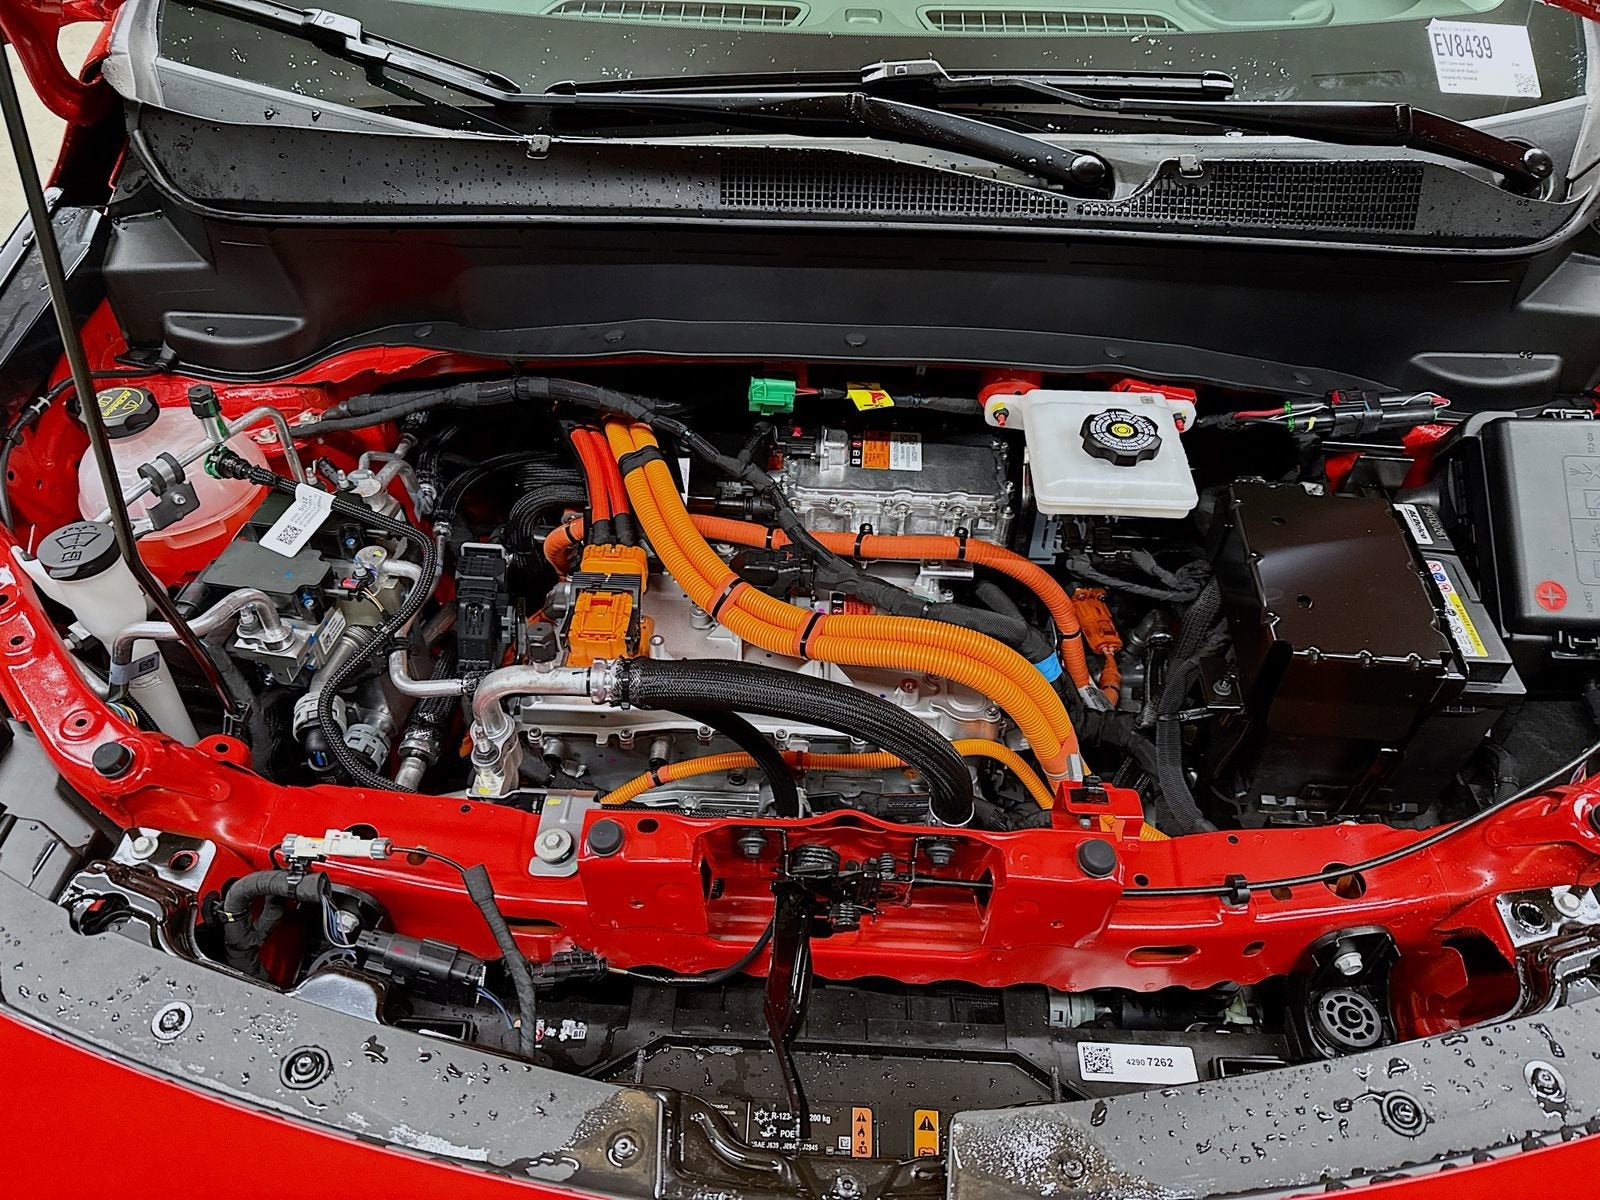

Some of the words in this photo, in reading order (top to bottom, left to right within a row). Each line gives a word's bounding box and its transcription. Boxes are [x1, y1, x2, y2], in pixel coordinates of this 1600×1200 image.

[1433, 32, 1493, 59] EV8439
[1408, 509, 1428, 540] ACDelco
[1126, 1058, 1146, 1066] 4290
[1147, 1057, 1174, 1068] 7262
[822, 1114, 831, 1124] kg
[780, 1130, 796, 1138] POE
